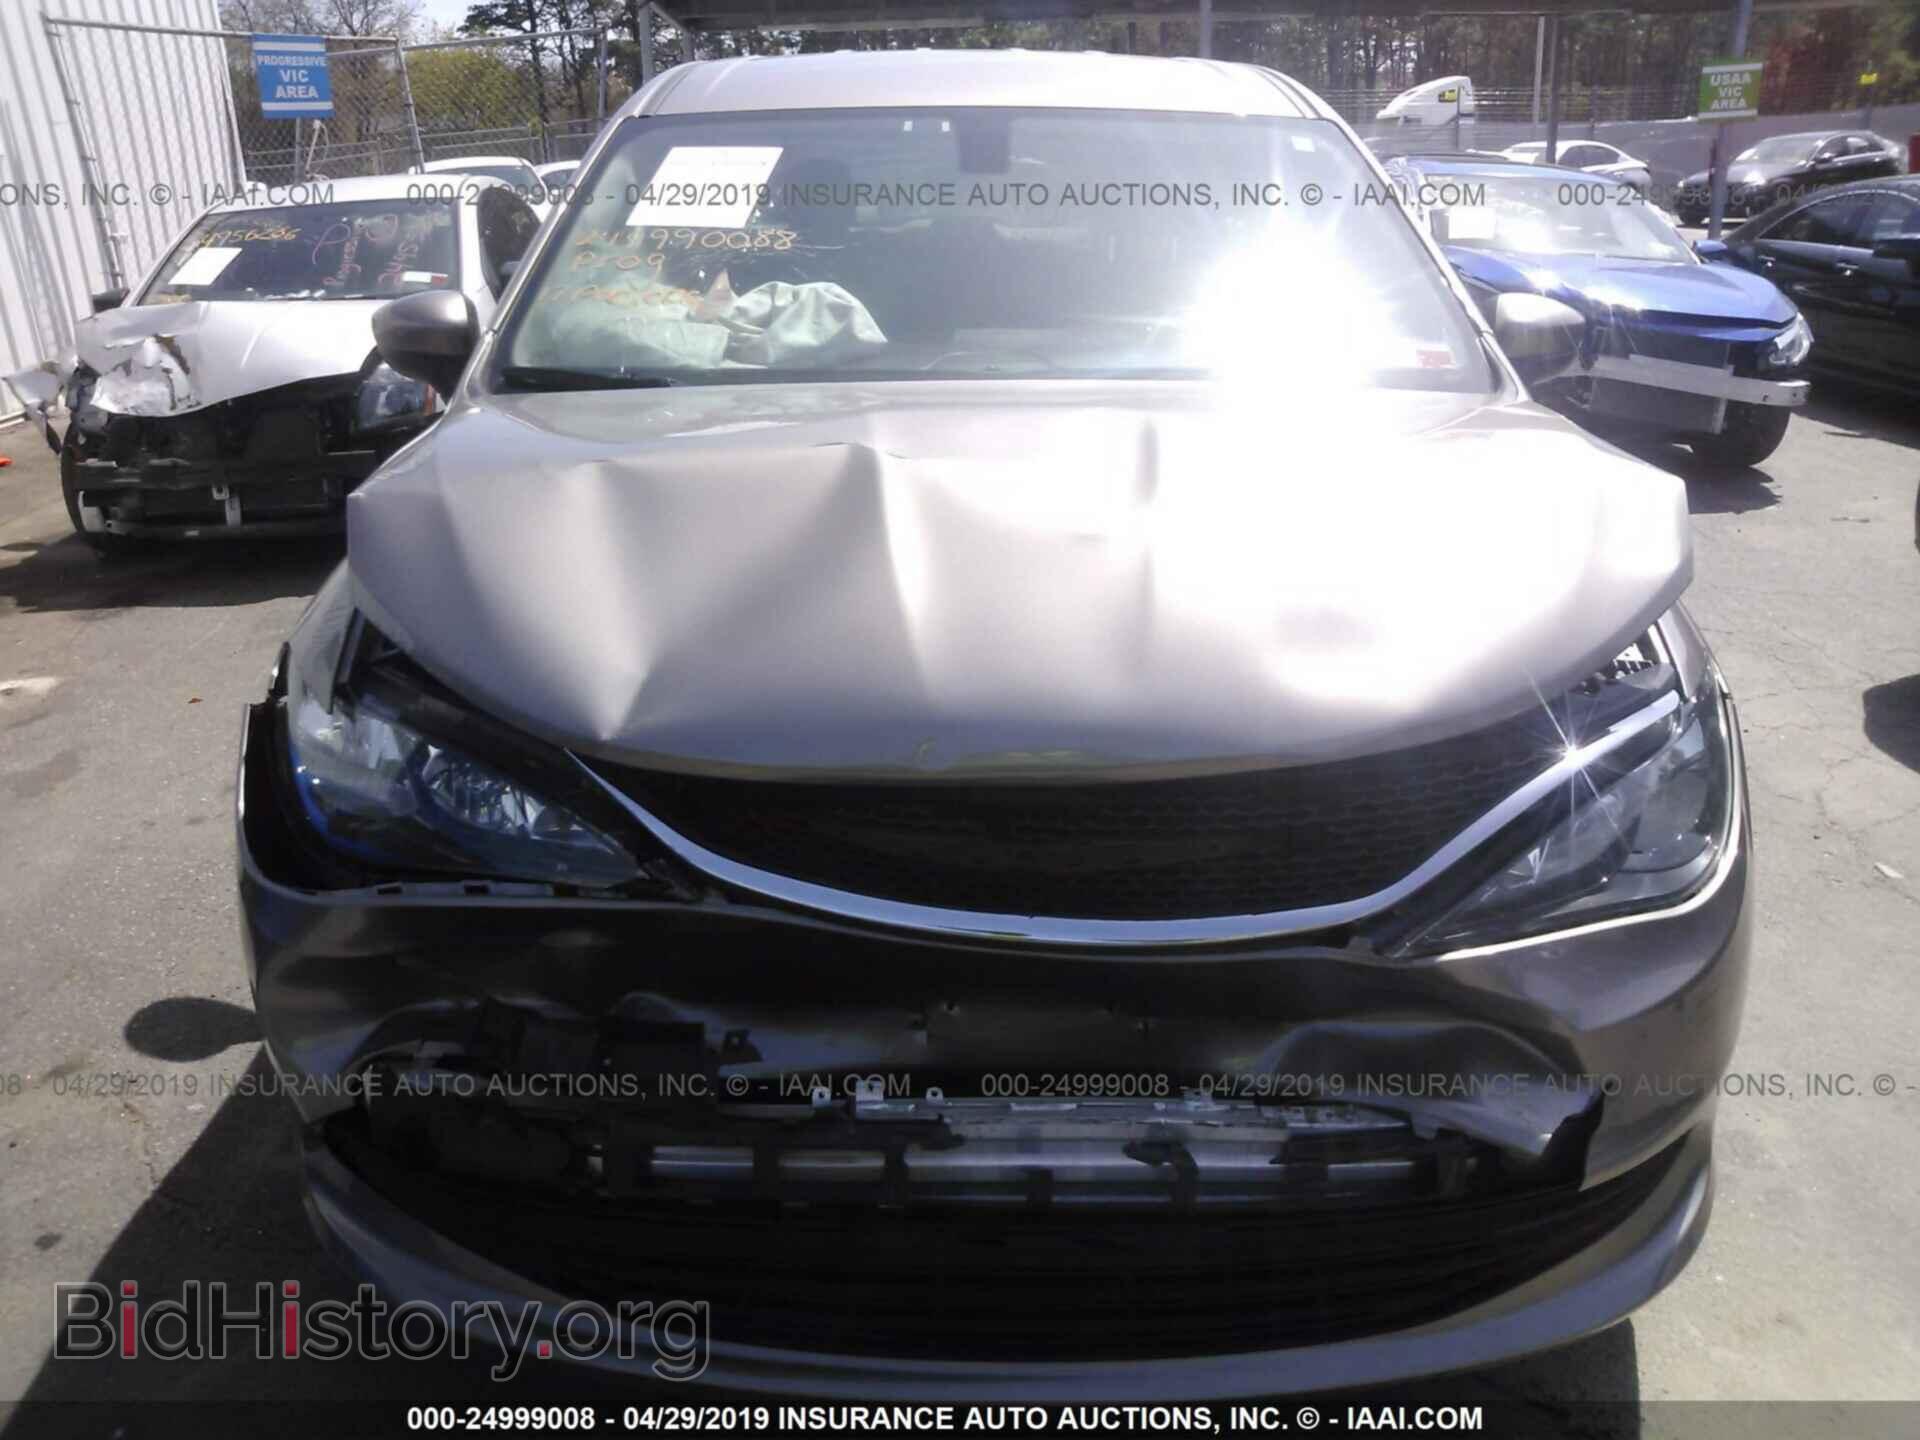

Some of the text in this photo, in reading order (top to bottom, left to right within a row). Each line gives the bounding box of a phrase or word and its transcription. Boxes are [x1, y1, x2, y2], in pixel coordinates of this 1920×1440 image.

[256, 55, 327, 67] PROGRESSIVE
[280, 69, 310, 83] VIC
[1711, 71, 1753, 87] USAA
[275, 86, 320, 99] AREA
[1718, 86, 1744, 98] VIC
[1710, 98, 1749, 111] AREA
